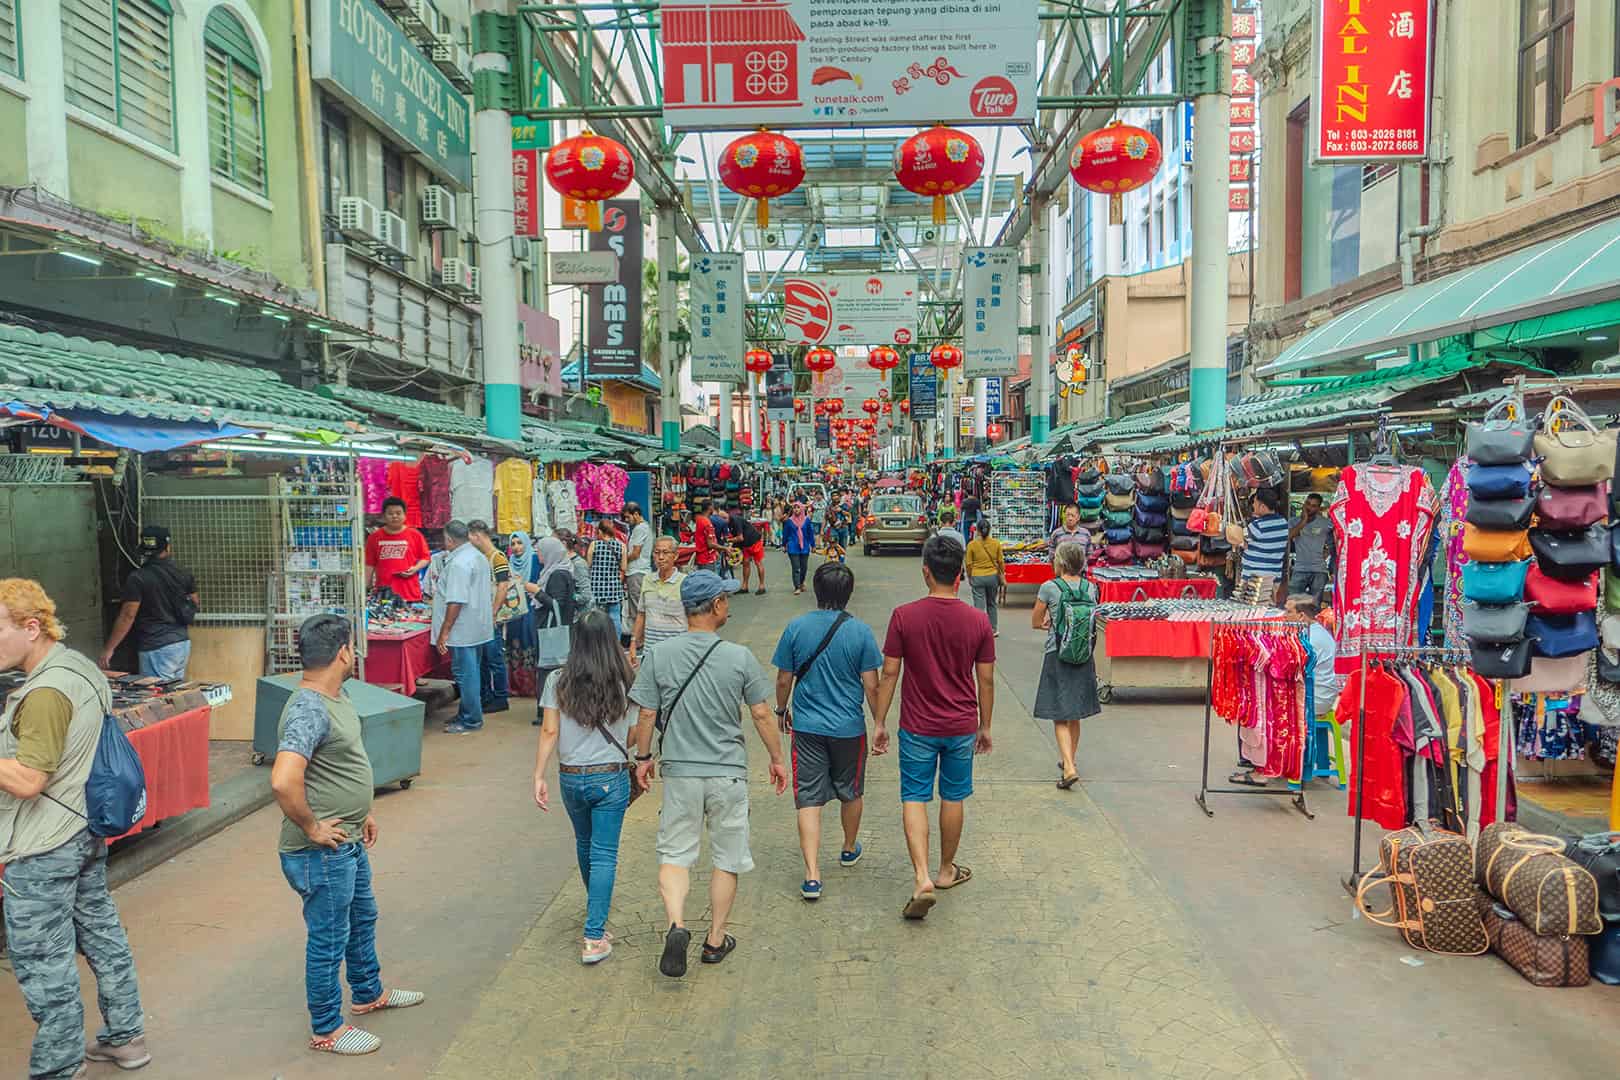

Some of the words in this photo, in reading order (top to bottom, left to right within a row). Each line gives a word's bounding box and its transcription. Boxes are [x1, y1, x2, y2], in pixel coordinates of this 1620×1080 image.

[810, 8, 874, 17] pemprosesan
[877, 7, 911, 16] tepung
[913, 7, 937, 16] yang
[940, 5, 970, 14] dibina
[973, 5, 982, 13] di
[985, 5, 1001, 13] sini
[810, 19, 834, 28] pada
[836, 18, 861, 27] abad
[810, 35, 843, 44] Petaling
[845, 34, 869, 43] Street
[889, 33, 917, 42] named
[919, 33, 938, 41] after
[940, 32, 953, 41] the
[955, 32, 971, 40] first
[810, 45, 879, 54] Starch-producing
[881, 43, 910, 53] factory
[912, 43, 929, 52] that
[948, 42, 967, 50] built
[969, 42, 987, 50] here
[989, 42, 997, 50] in
[810, 54, 823, 63] the
[841, 54, 872, 64] Century
[340, 0, 398, 76] HOTEL
[400, 45, 445, 120] EXCEL
[447, 93, 466, 143] INN
[814, 94, 884, 104] tunetalk.com
[974, 87, 1014, 113] Tune
[1336, 65, 1369, 123] INN
[1327, 130, 1340, 139] Tel
[1351, 129, 1394, 139] 603-2026
[1397, 129, 1416, 138] 8181
[1351, 141, 1395, 151] 603-2072
[1396, 140, 1419, 150] 6666
